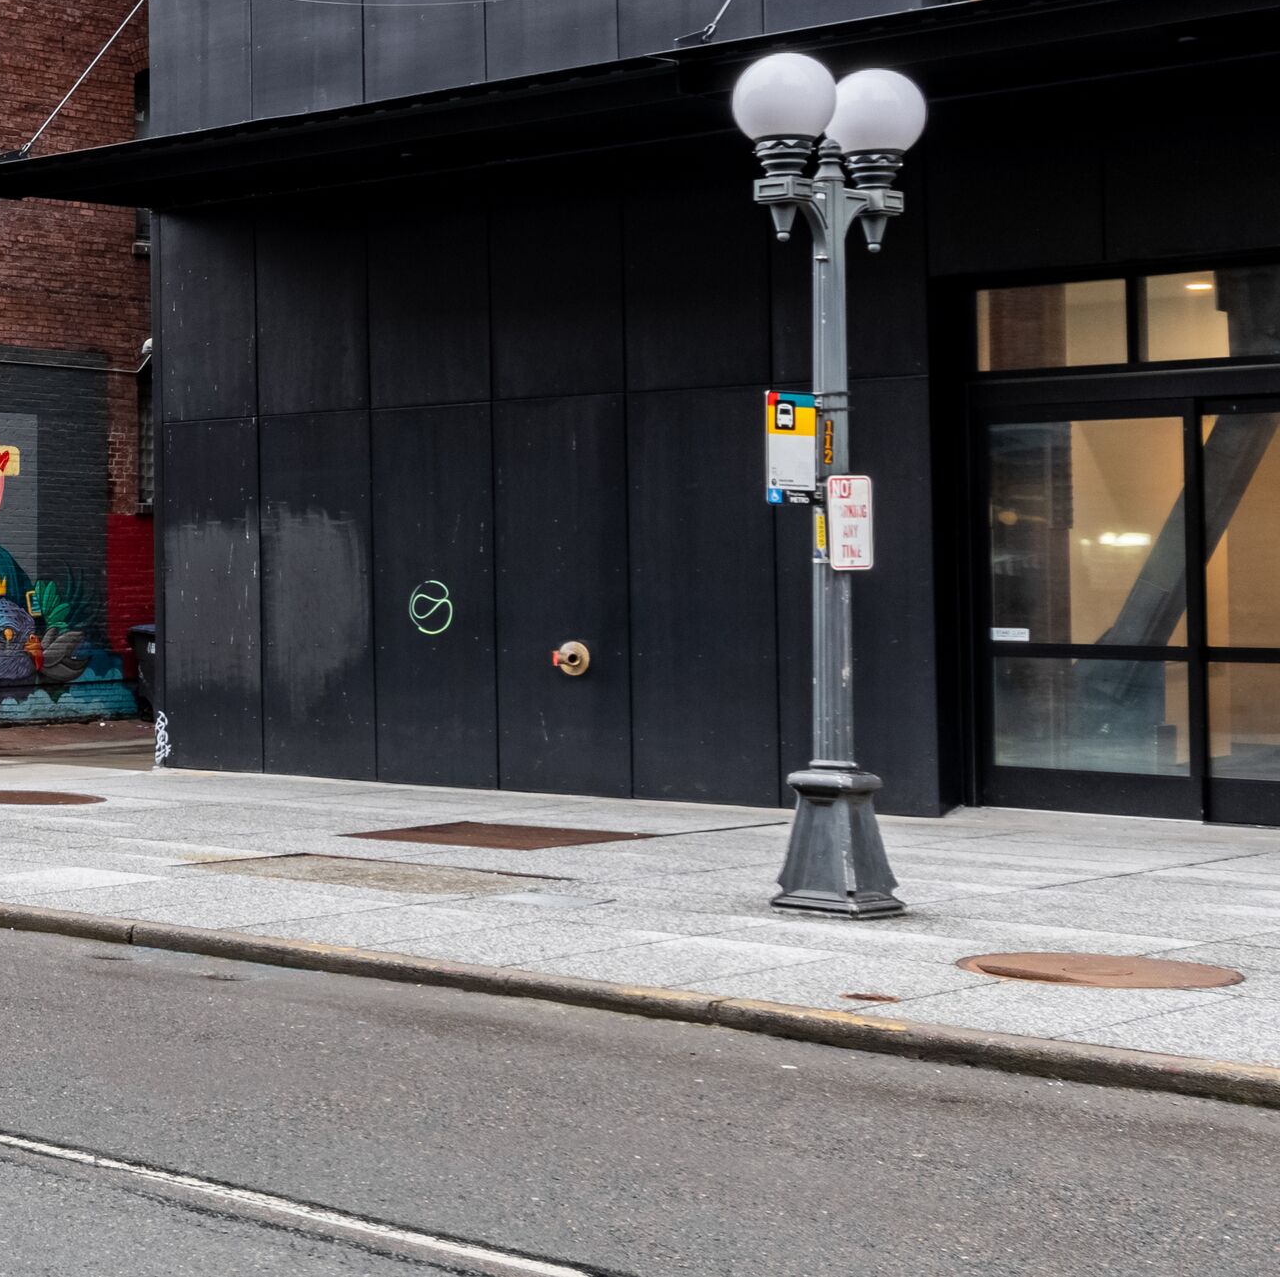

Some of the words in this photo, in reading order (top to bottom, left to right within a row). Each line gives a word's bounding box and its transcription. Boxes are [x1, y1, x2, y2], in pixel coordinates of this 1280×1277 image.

[824, 420, 834, 465] 112
[831, 480, 850, 498] NO
[841, 504, 867, 518] RKING
[842, 525, 859, 539] ANY
[842, 544, 862, 559] TIME
